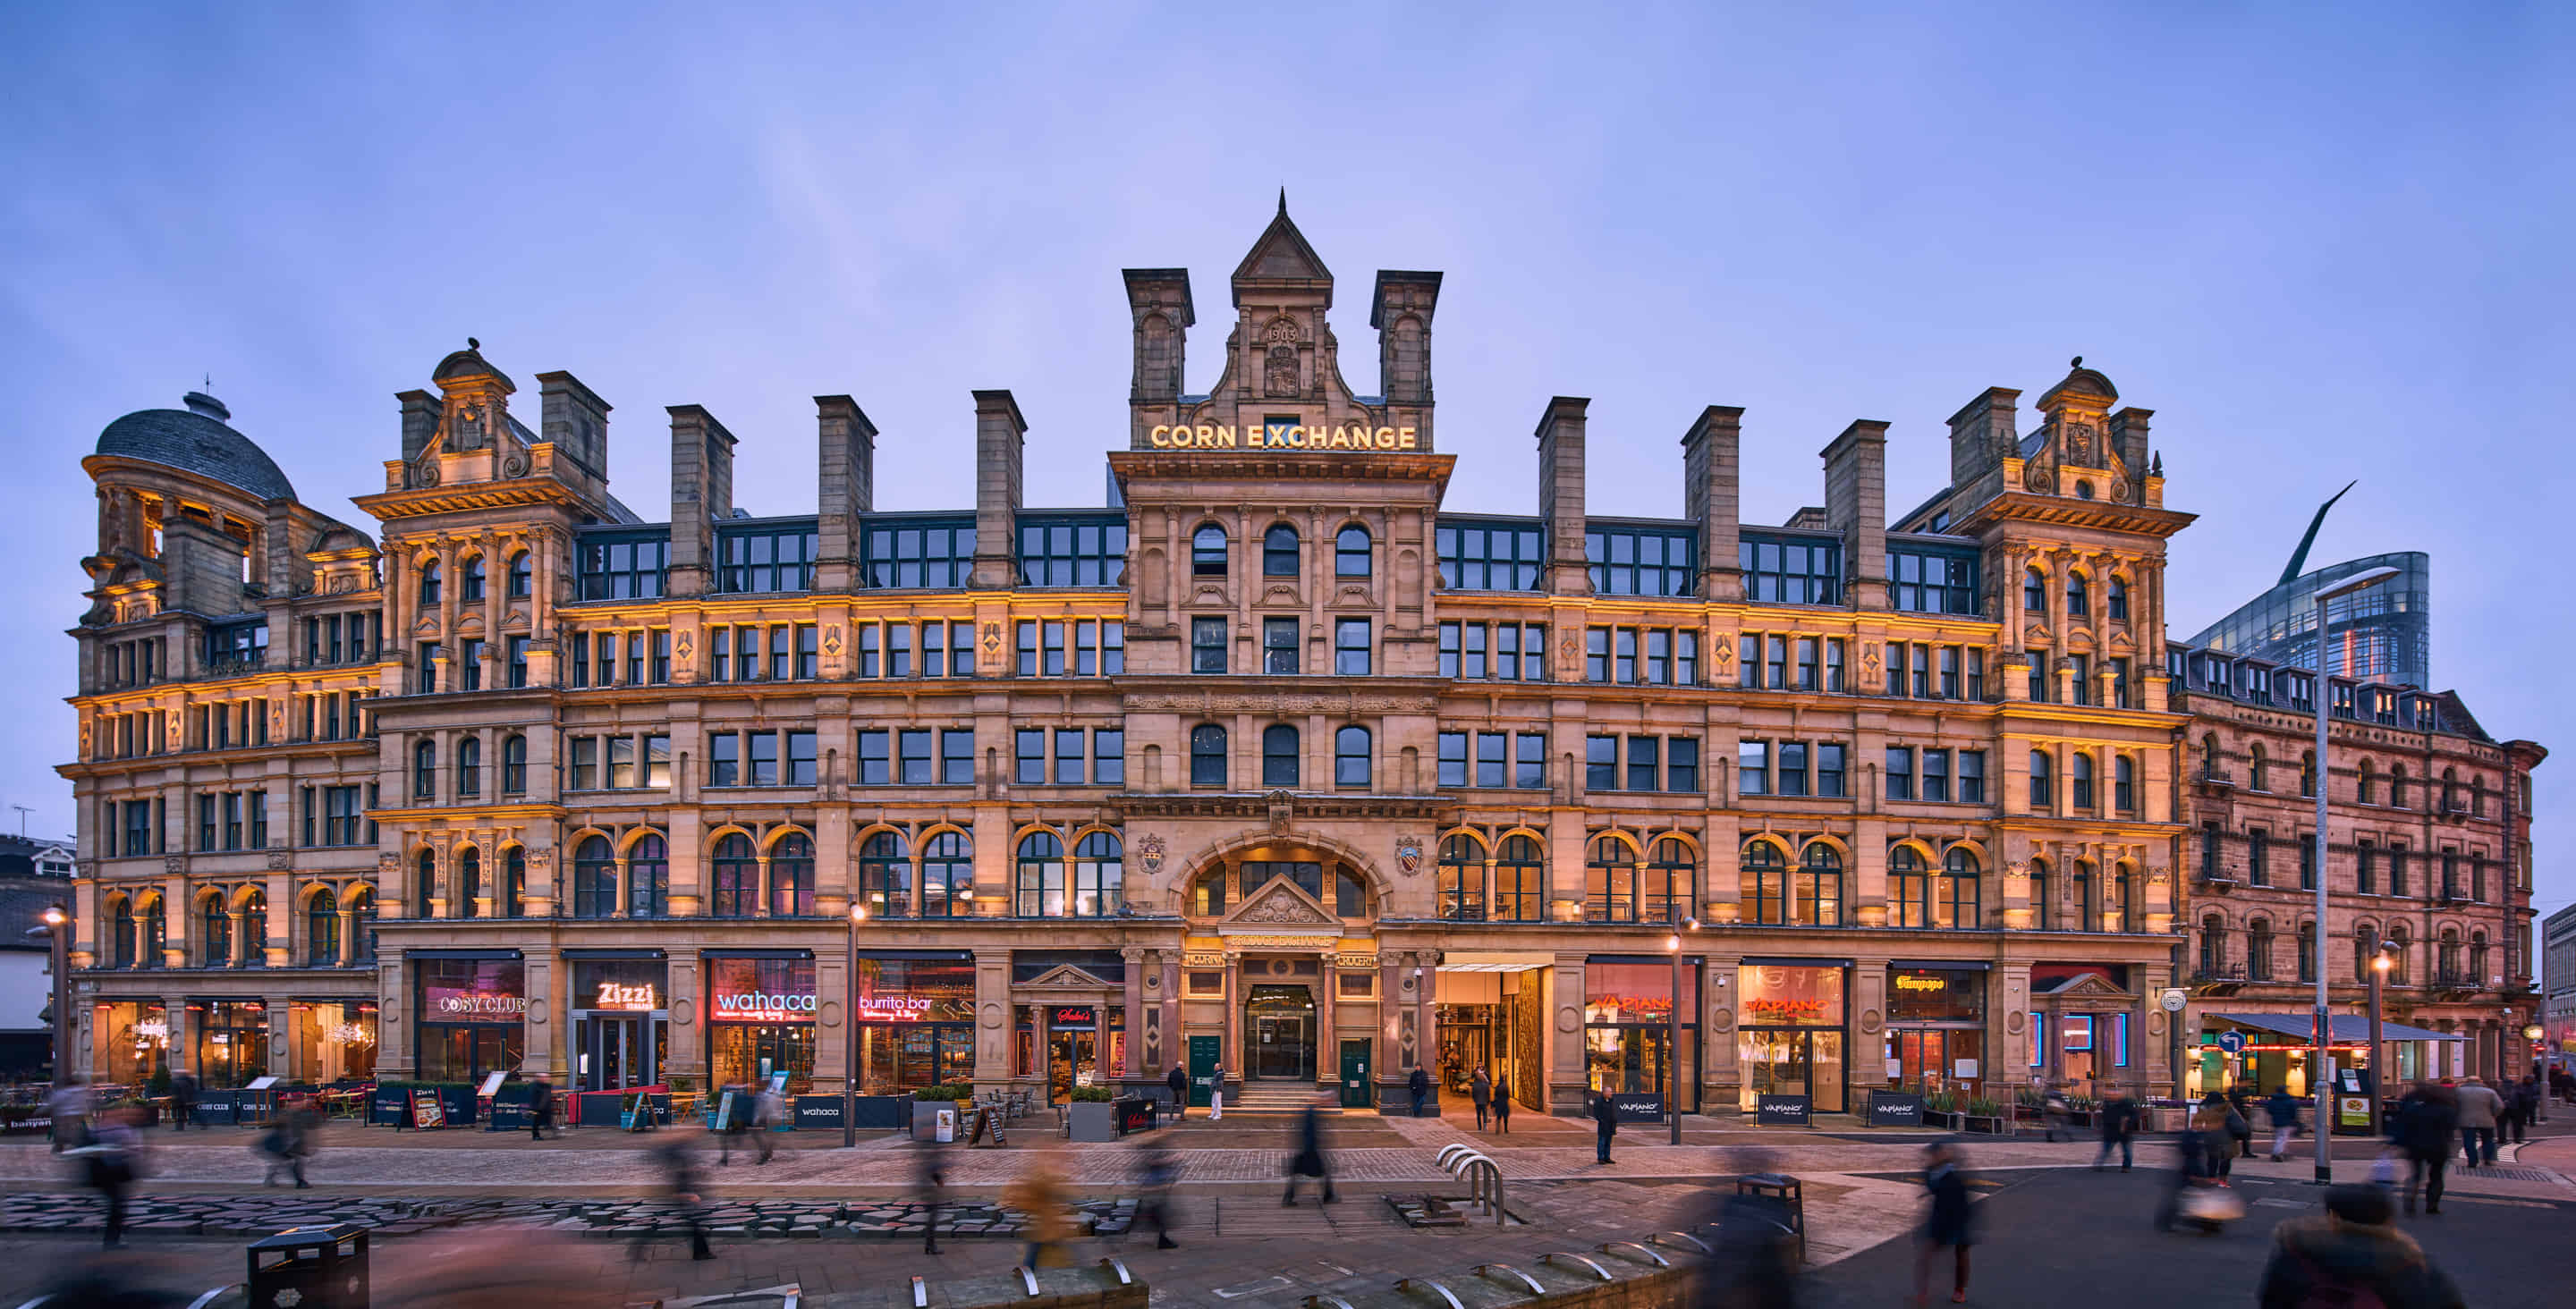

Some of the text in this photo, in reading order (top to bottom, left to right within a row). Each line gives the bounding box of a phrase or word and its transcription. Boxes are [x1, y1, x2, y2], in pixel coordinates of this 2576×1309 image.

[1150, 425, 1416, 448] CORN EXCHANGE
[1232, 935, 1331, 948] PRODUCE EXCHANGE
[597, 982, 654, 1002] Zizzi
[441, 997, 526, 1012] COSY CLUB
[717, 990, 816, 1011] wahaca
[860, 996, 932, 1009] burrito bar
[1746, 996, 1830, 1014] VAPIANO
[802, 1107, 839, 1116] wahaca
